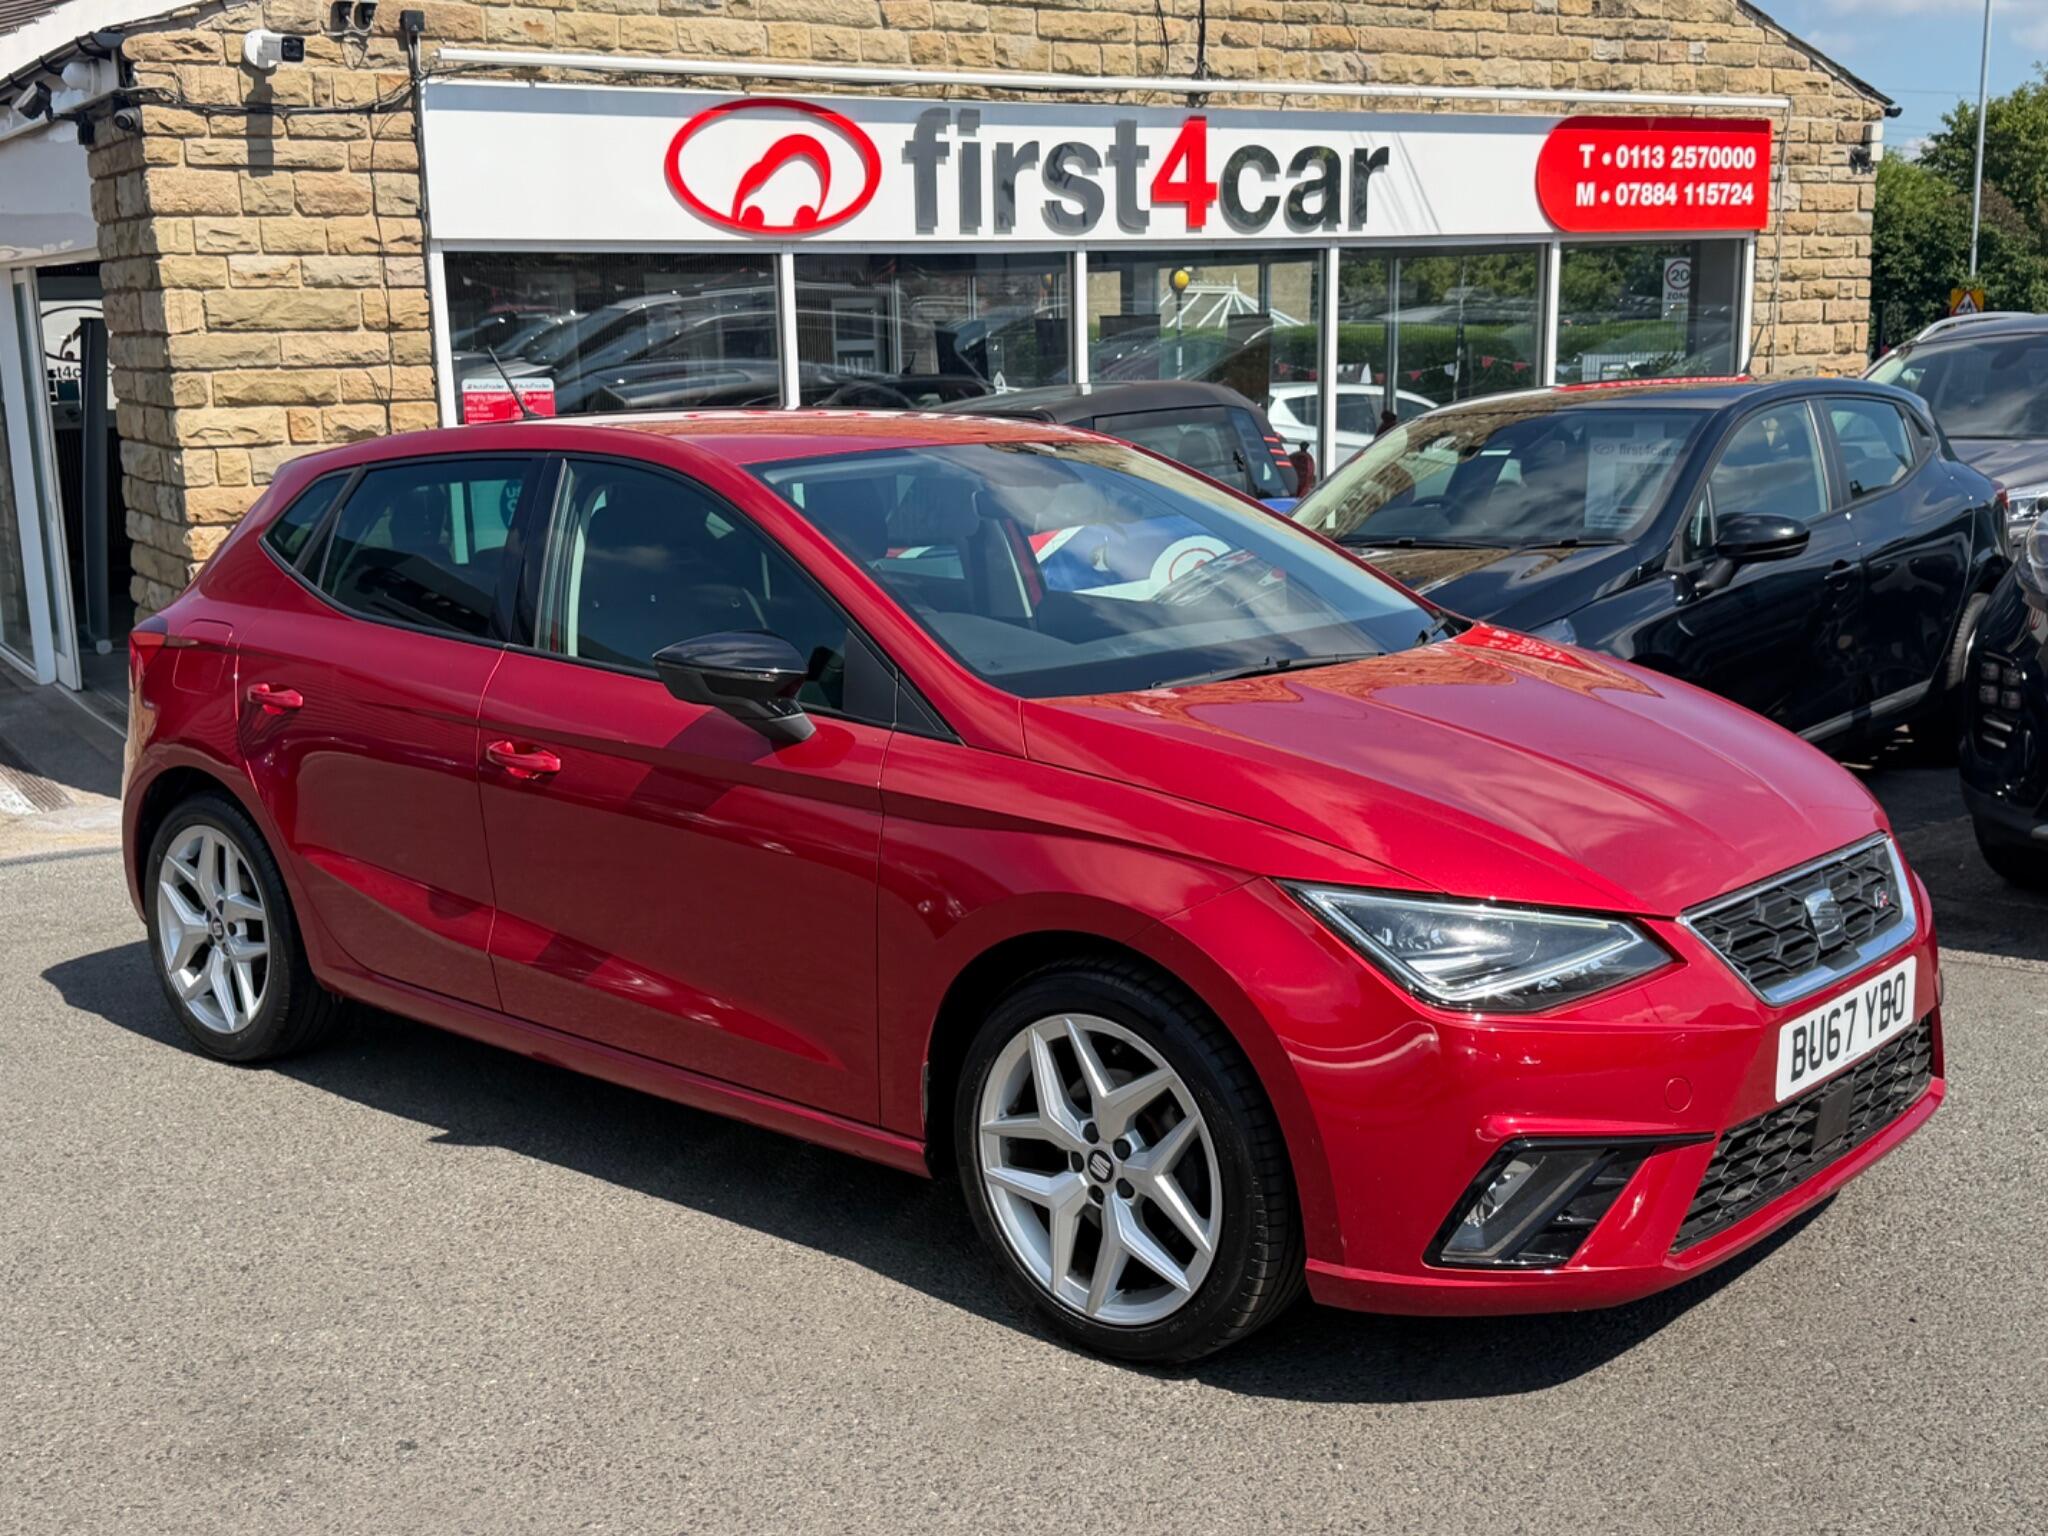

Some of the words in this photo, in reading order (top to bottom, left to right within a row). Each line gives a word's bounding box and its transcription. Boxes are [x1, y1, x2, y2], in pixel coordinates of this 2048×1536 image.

[1578, 144, 1596, 168] T
[1615, 145, 1665, 169] 0113
[1670, 146, 1757, 169] 2570000
[903, 108, 1389, 234] first4car
[1575, 182, 1596, 207] M
[1615, 182, 1678, 206] 07884
[1684, 182, 1754, 206] 115724
[1671, 269, 1689, 281] 20
[1791, 997, 1858, 1082] BU67
[1865, 971, 1906, 1039] YBO
